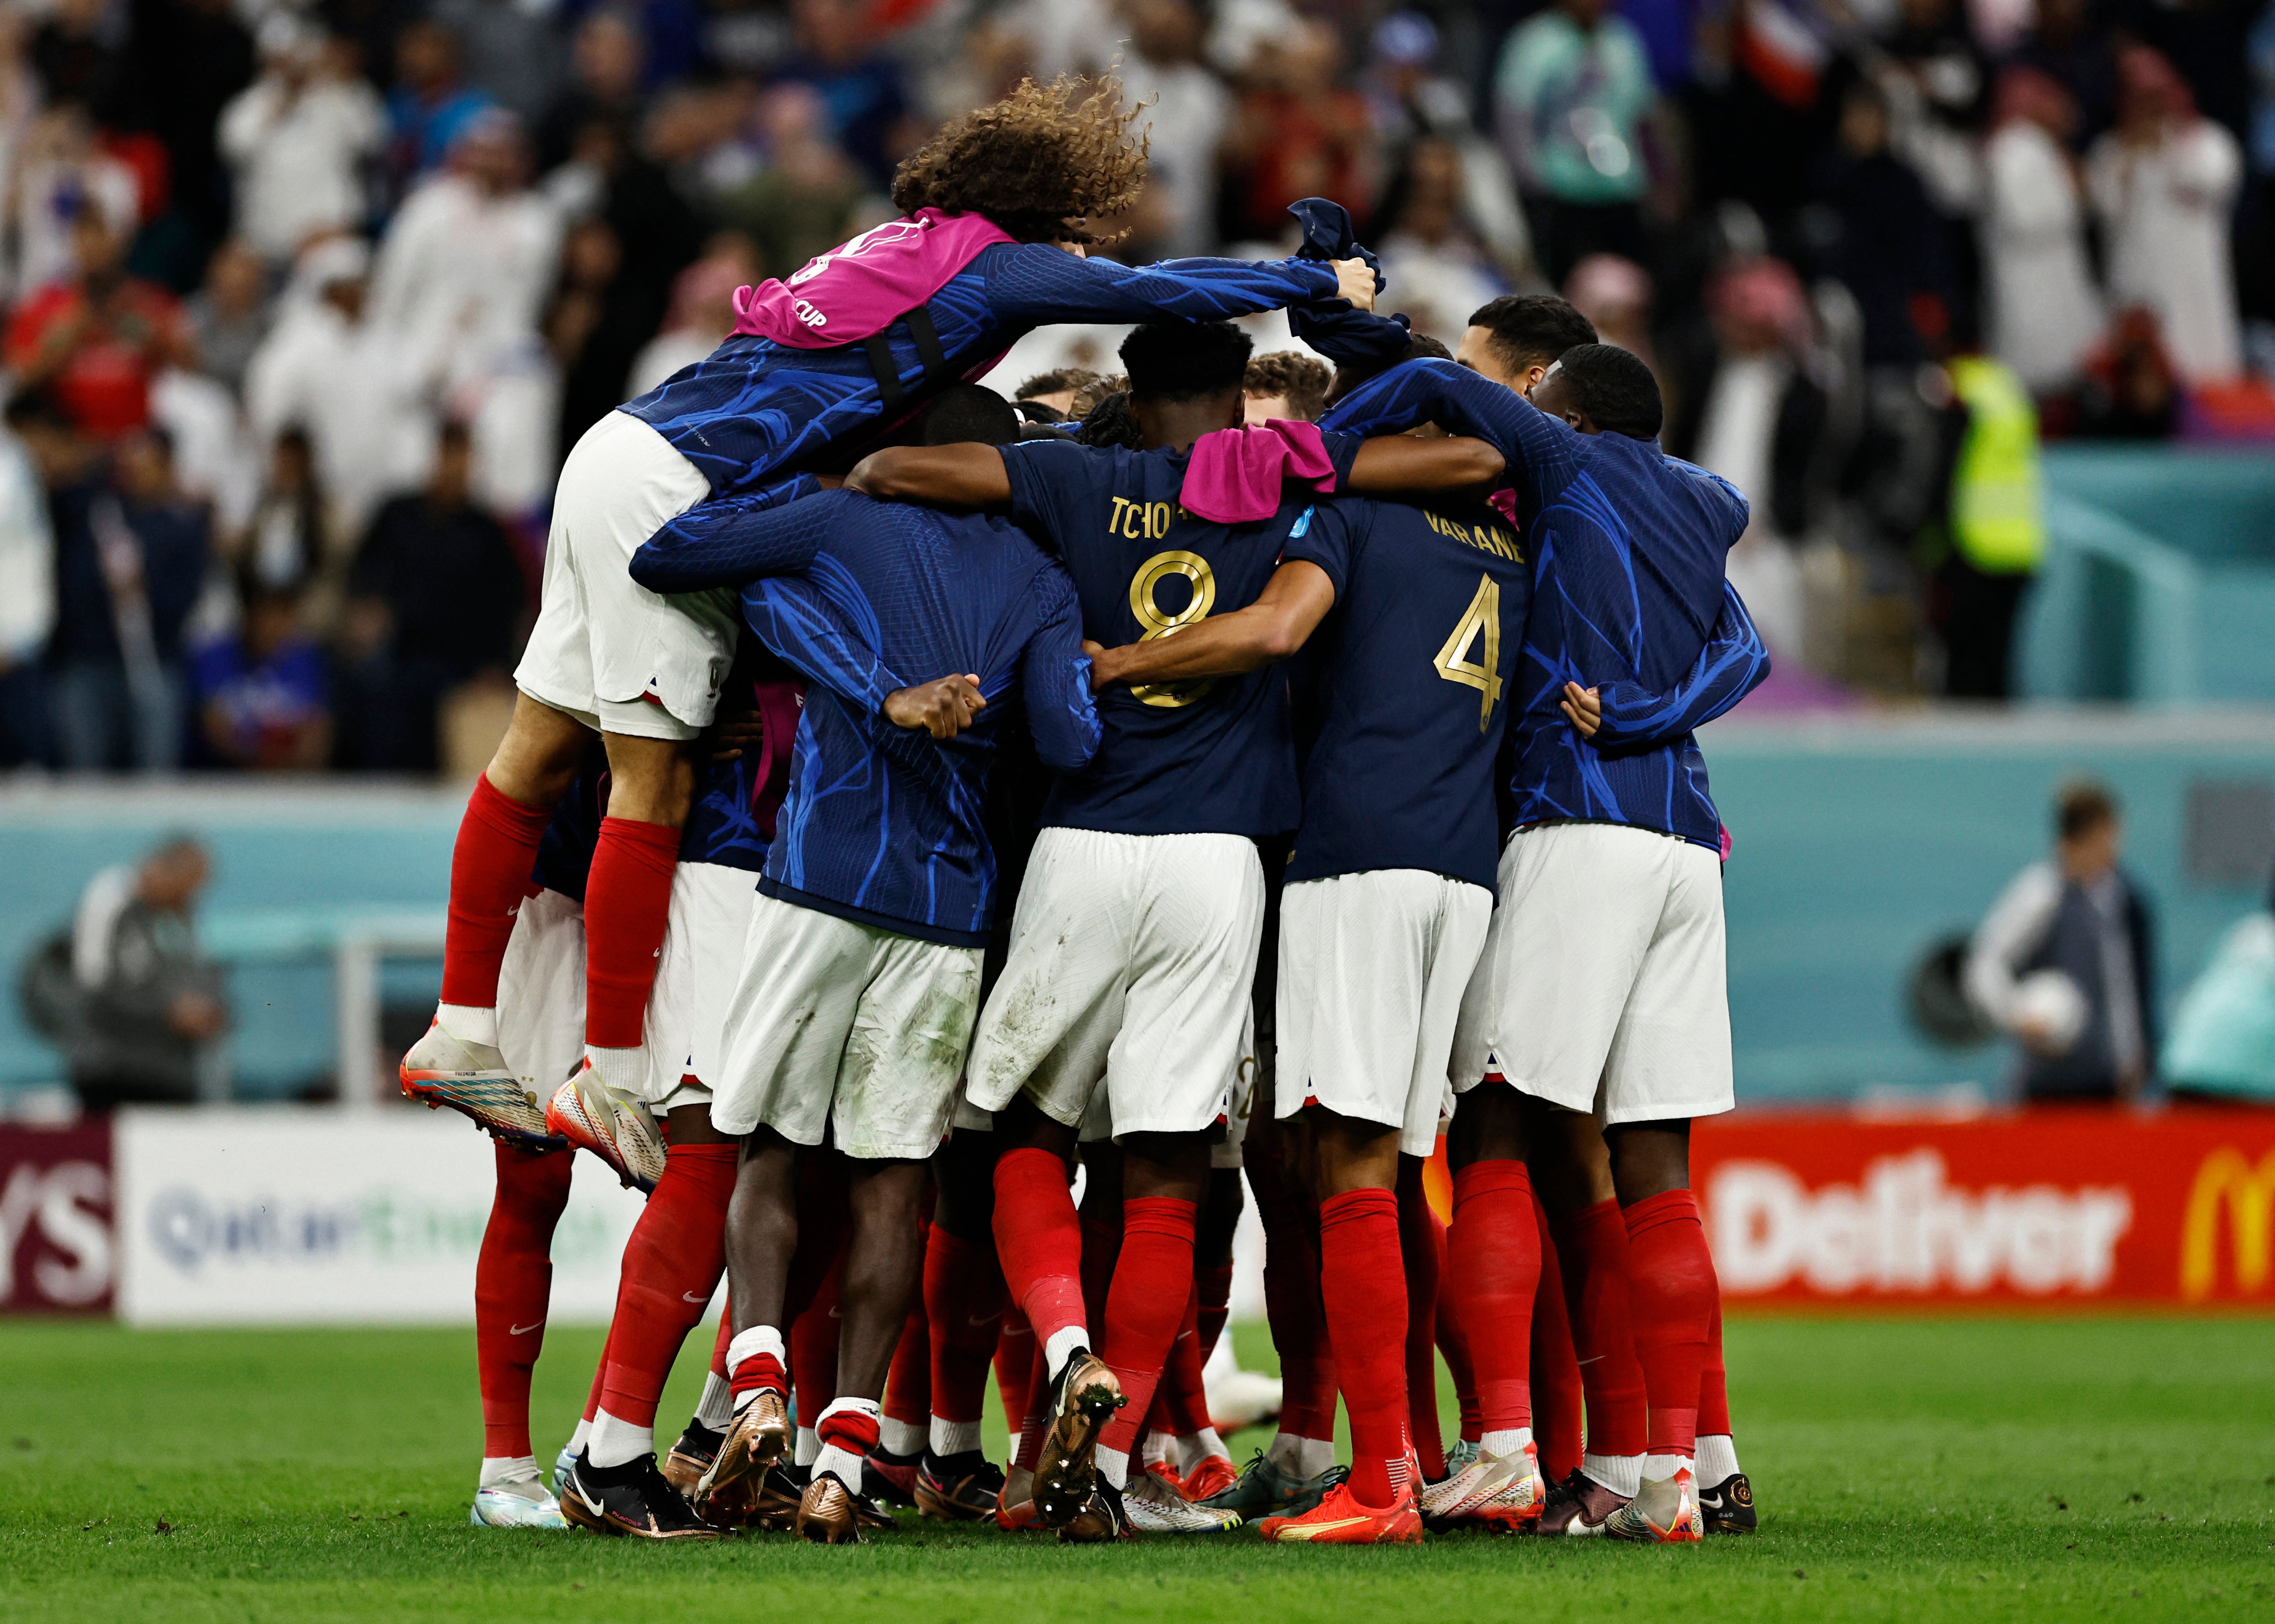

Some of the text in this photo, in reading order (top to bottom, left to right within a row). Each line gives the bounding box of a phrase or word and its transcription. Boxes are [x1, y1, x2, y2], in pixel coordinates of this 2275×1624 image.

[796, 300, 827, 327] CUP
[1422, 509, 1525, 564] VARANE
[1130, 550, 1216, 708] 8
[1433, 572, 1503, 734] 4
[612, 1510, 637, 1526] PHANTOM
